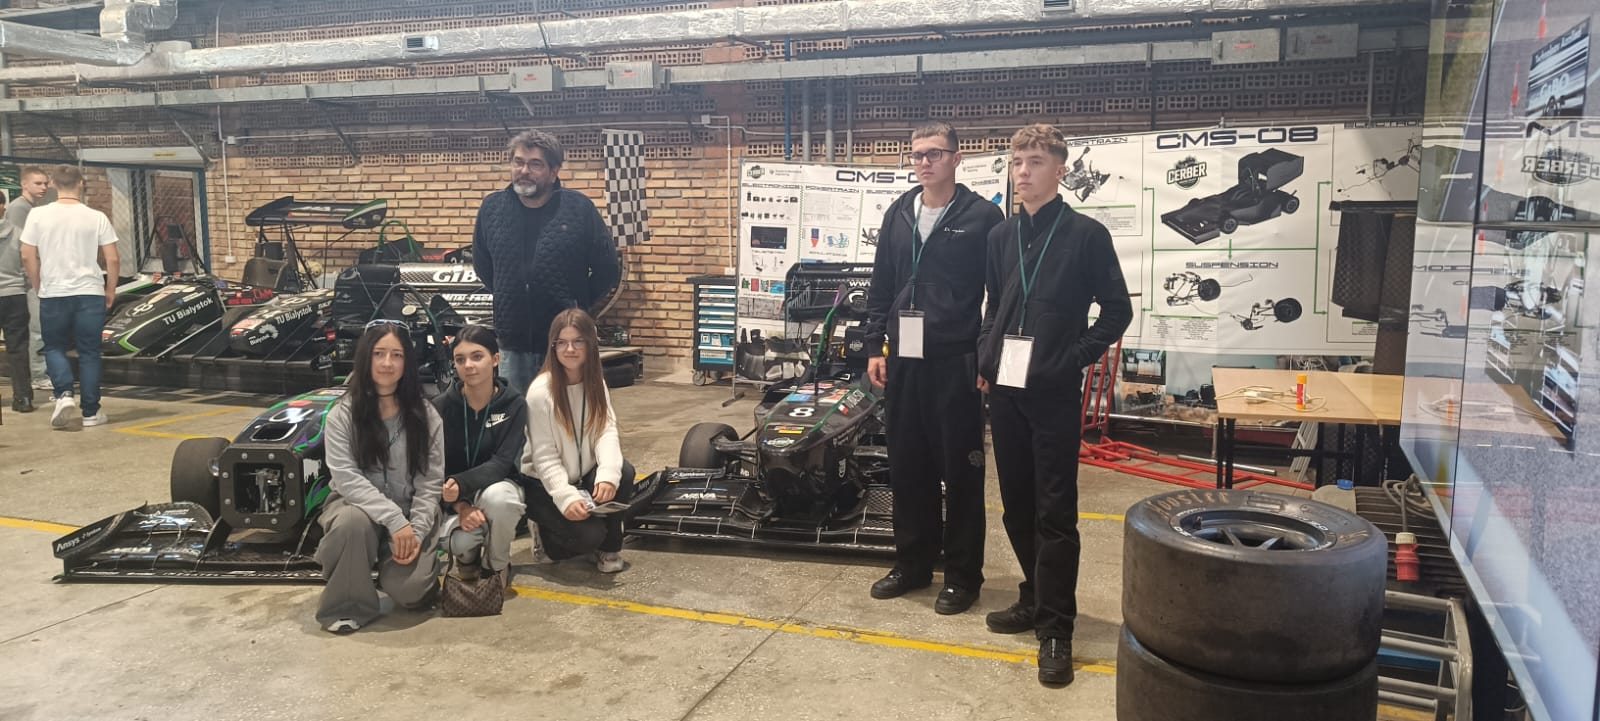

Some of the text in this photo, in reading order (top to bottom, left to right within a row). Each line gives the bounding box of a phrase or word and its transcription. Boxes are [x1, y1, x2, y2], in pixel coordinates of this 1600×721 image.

[1157, 127, 1318, 150] CMS-08
[1168, 163, 1207, 183] CERBER
[1185, 261, 1278, 269] SUSPENSION
[163, 314, 176, 326] TU
[275, 314, 285, 325] TU
[788, 407, 815, 418] 8
[56, 537, 80, 553] Ansys
